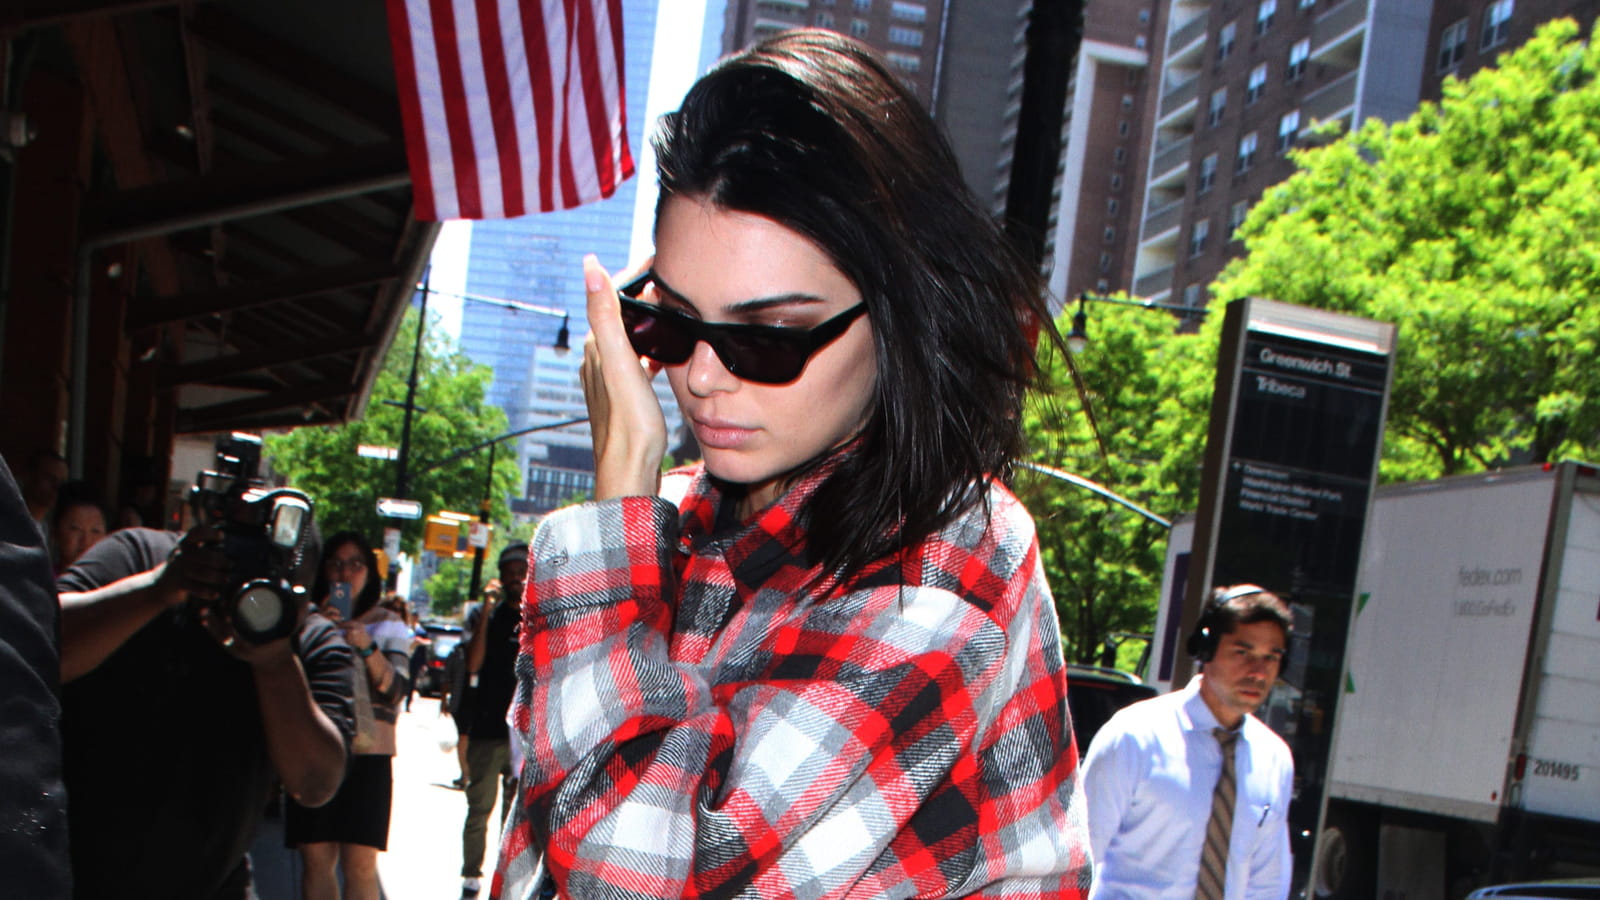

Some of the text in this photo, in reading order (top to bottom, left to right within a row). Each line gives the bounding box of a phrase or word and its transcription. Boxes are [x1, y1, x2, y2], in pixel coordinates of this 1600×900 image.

[1260, 348, 1351, 378] Greenwich St
[1256, 375, 1305, 399] Tribeca
[1459, 566, 1521, 586] fedex.com
[1534, 760, 1579, 781] 201495
